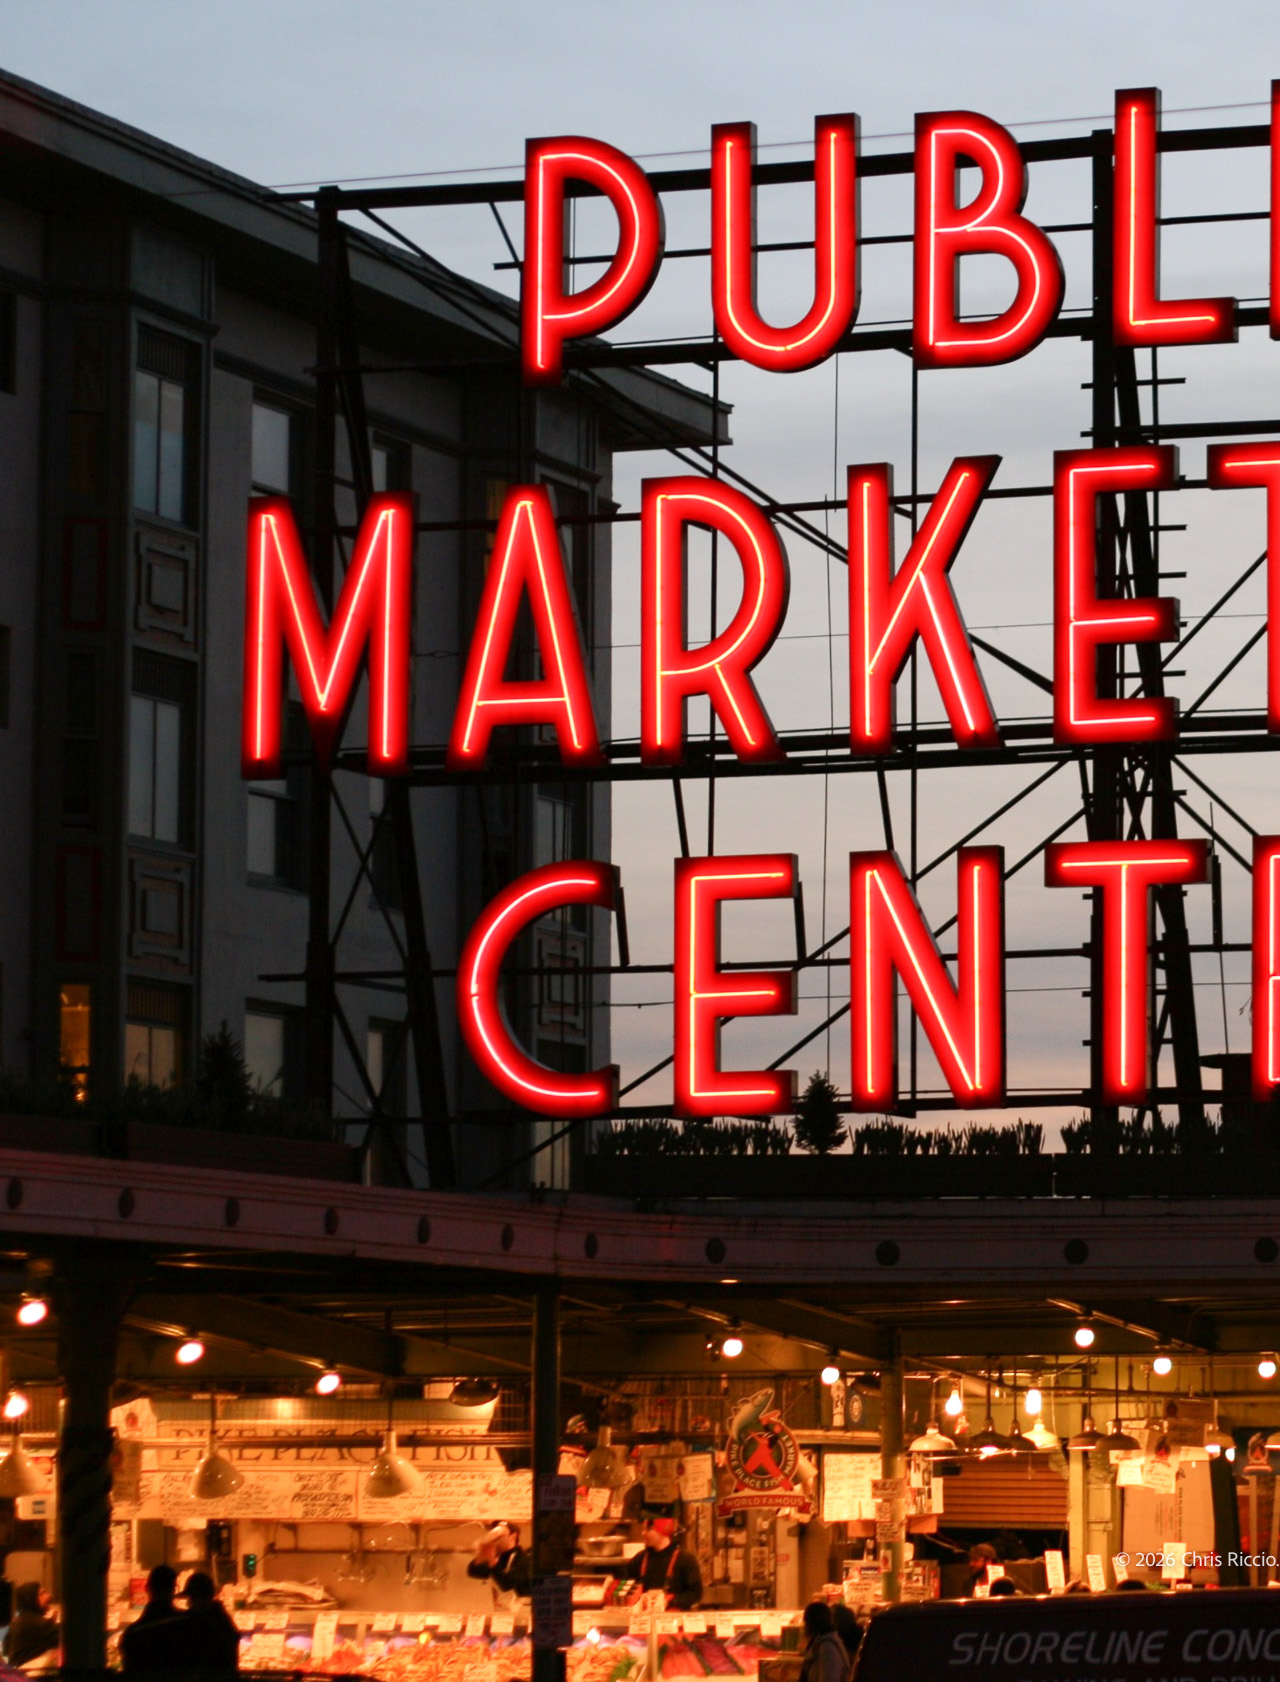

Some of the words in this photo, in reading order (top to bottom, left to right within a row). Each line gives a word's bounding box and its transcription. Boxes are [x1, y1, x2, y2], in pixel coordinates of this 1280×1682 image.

[735, 1467, 762, 1489] PLACE
[780, 1433, 796, 1476] MARKET
[725, 1497, 760, 1507] WORLD
[761, 1496, 804, 1506] FAMOUS
[948, 1629, 1170, 1665] SHORELINE
